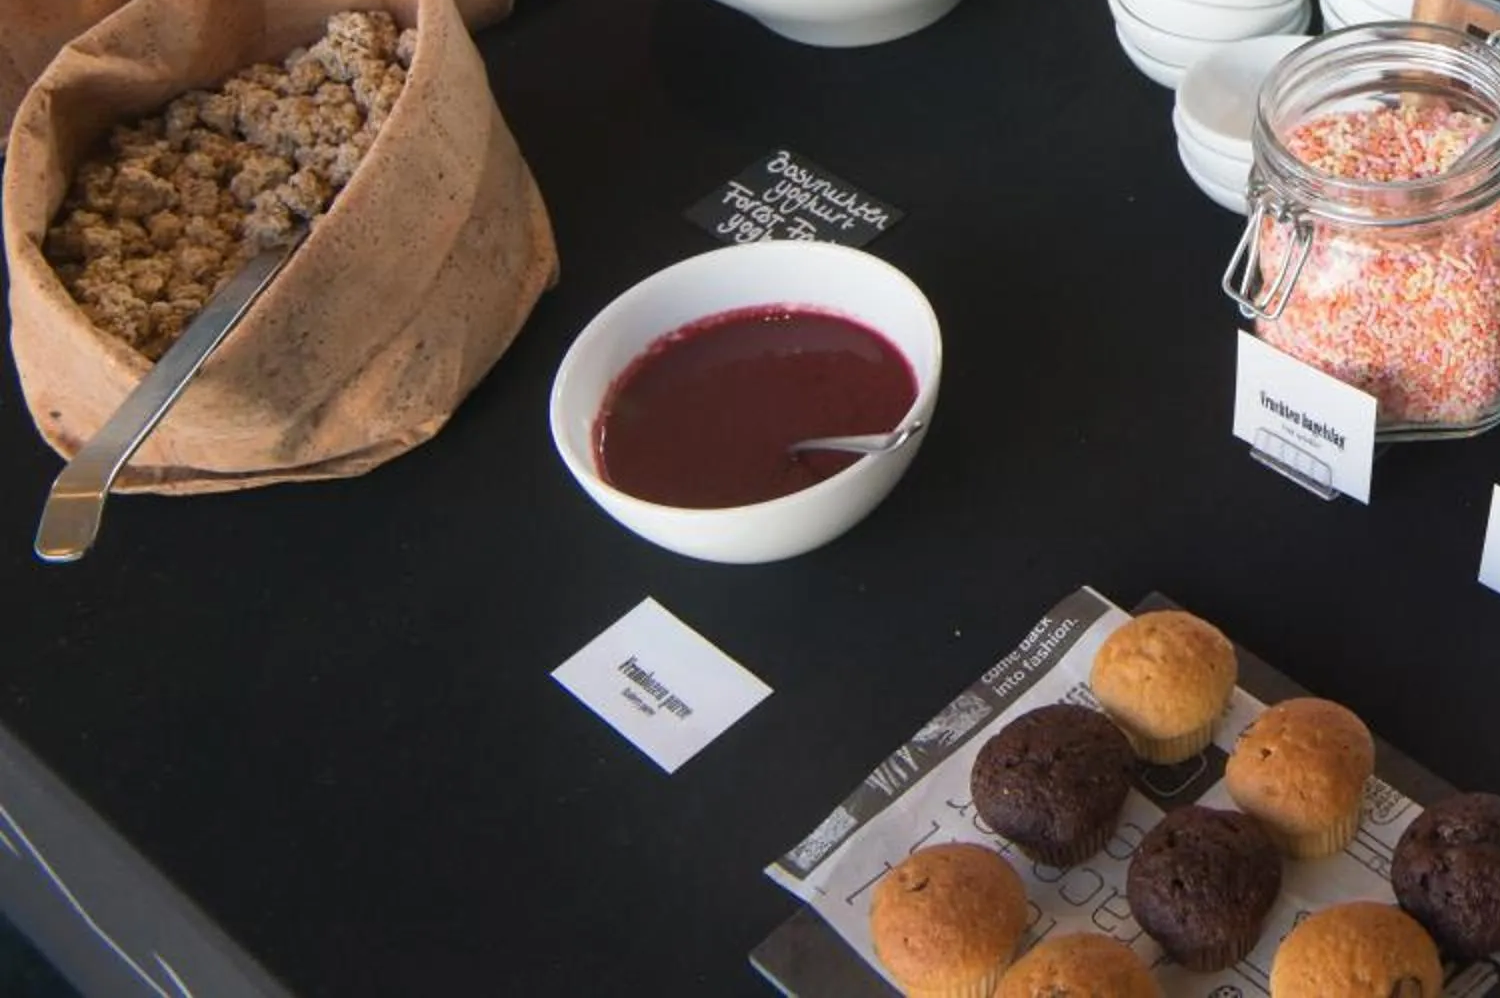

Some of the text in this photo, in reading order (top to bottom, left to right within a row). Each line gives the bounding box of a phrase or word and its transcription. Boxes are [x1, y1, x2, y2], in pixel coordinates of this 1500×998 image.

[1301, 412, 1346, 451] hagelslag
[981, 650, 1021, 683] come
[992, 670, 1026, 698] into
[1023, 617, 1079, 672] fashion.
